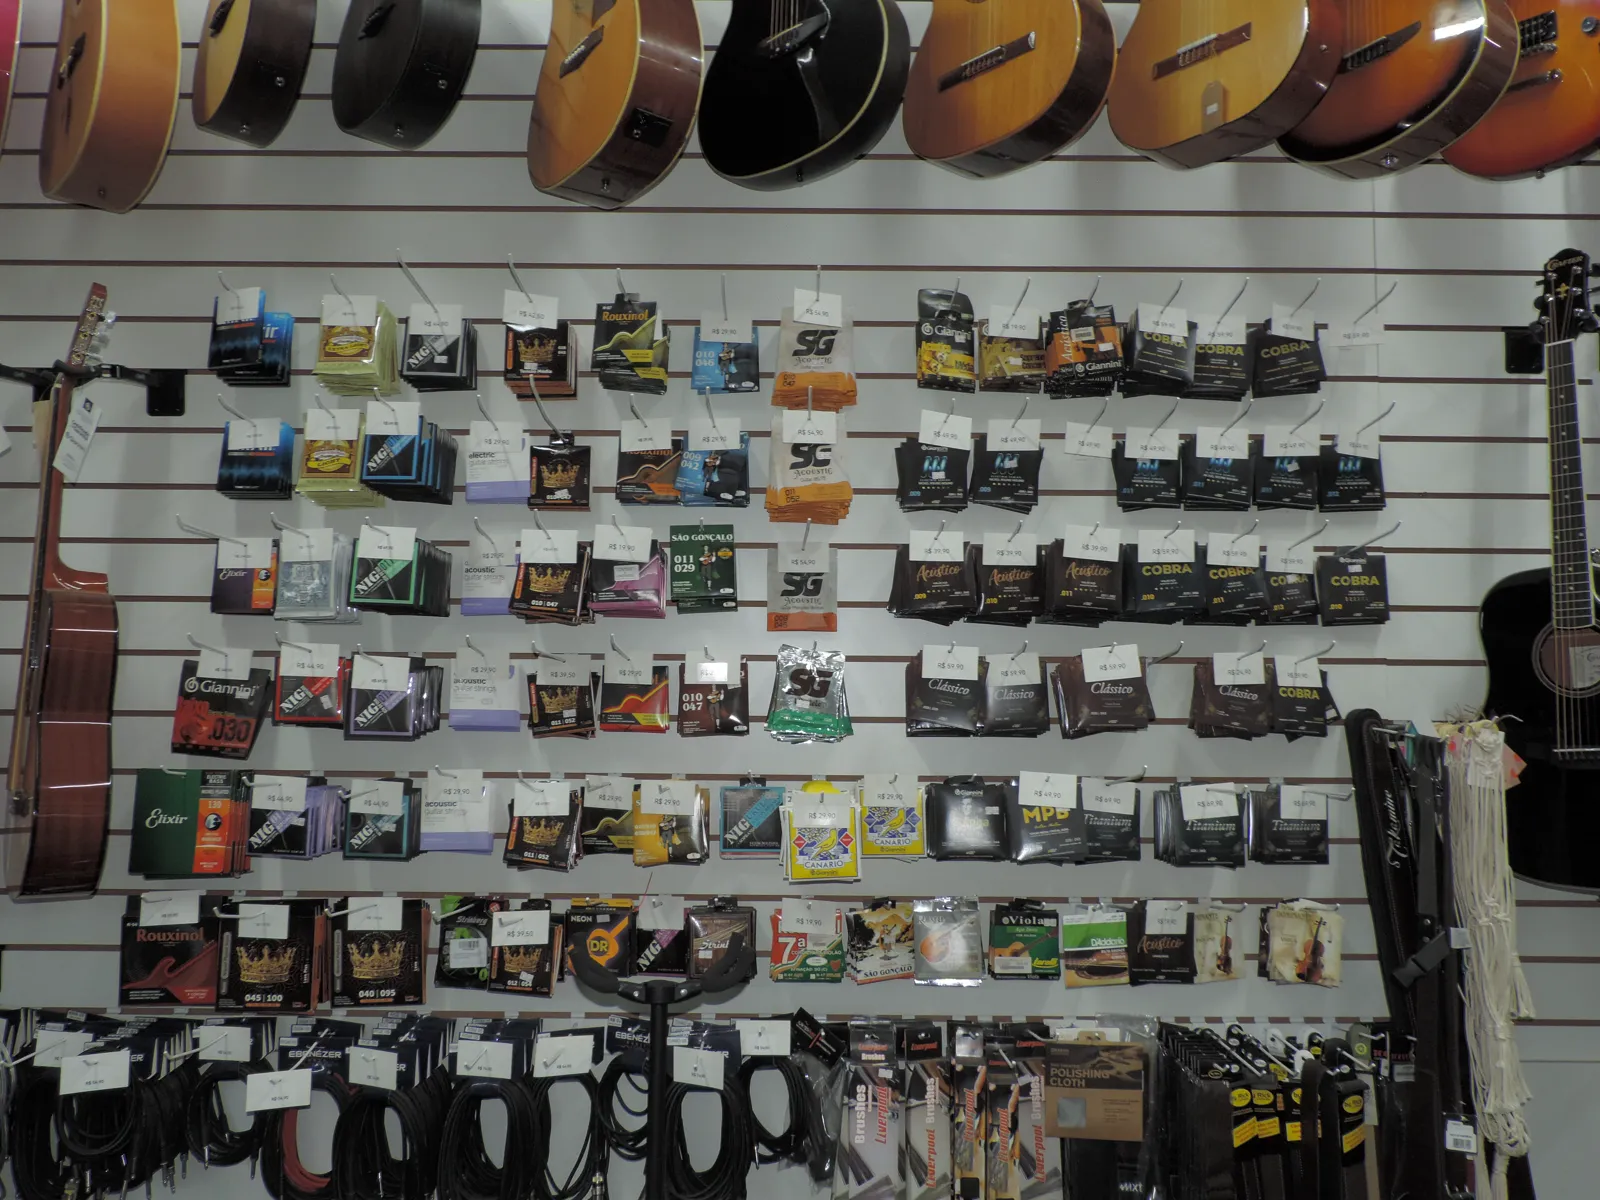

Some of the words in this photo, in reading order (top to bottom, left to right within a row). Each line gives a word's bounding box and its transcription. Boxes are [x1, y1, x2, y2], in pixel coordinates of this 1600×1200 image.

[602, 310, 649, 322] Rouxinol
[792, 329, 838, 357] SG
[1260, 340, 1311, 359] COBRA
[1196, 344, 1244, 356] COBRA
[407, 346, 430, 368] NIG
[696, 359, 716, 367] 046
[1085, 360, 1123, 371] Giannini
[367, 449, 389, 472] NIG
[468, 452, 496, 460] electric
[683, 452, 701, 462] 009
[680, 461, 700, 471] 042
[671, 533, 689, 542] SÃO
[691, 533, 734, 543] GONÇALO
[674, 554, 694, 564] 011
[464, 565, 495, 574] acoustic
[674, 564, 696, 573] 029
[1142, 563, 1193, 576] COBRA
[1208, 567, 1255, 580] COBRA
[354, 573, 380, 595] NIG
[780, 572, 824, 597] SG
[1331, 575, 1380, 587] COBRA
[199, 679, 257, 697] Giannini
[928, 678, 971, 696] Clássico
[1090, 682, 1134, 695] Clássico
[1218, 685, 1259, 701] Clássico
[279, 685, 307, 714] NIG
[682, 693, 703, 702] 010
[993, 688, 1036, 701] Clássico
[1278, 687, 1320, 701] COBRA
[682, 702, 703, 712] 047
[354, 704, 380, 728] NIG
[208, 717, 251, 743] .030
[145, 808, 188, 829] Elixir
[1022, 806, 1070, 824] MPB
[1084, 813, 1133, 828] Titanium
[724, 818, 750, 845] NIG
[1185, 820, 1236, 832] Titanium
[1271, 819, 1321, 832] Titanium
[248, 822, 275, 849] NIG
[348, 823, 372, 850] NIG
[456, 915, 489, 926] Strinberg
[570, 915, 593, 923] NEON
[1008, 915, 1044, 925] Viola
[136, 927, 204, 943] Rouxinol
[590, 939, 608, 952] DR
[636, 940, 662, 972] NIG
[863, 969, 879, 978] SÃO
[879, 964, 913, 976] GONÇALO
[244, 994, 262, 1002] 045
[266, 993, 283, 1002] 100
[358, 990, 375, 998] 040
[380, 989, 396, 997] 095
[615, 1031, 651, 1044] EBENÉZ
[910, 1042, 938, 1051] Liverpool
[288, 1049, 342, 1059] EBENÉZER
[1050, 1068, 1110, 1079] POLISHING
[1049, 1077, 1086, 1088] CLOTH
[925, 1077, 936, 1124] Brushes
[1030, 1075, 1043, 1121] Brushes
[854, 1084, 867, 1144] Brushes
[874, 1086, 889, 1145] Liverpool
[964, 1088, 975, 1142] Liverpool
[997, 1107, 1009, 1163] Liverpool
[926, 1128, 937, 1189] Liverpool
[1034, 1124, 1046, 1183] Liverpool
